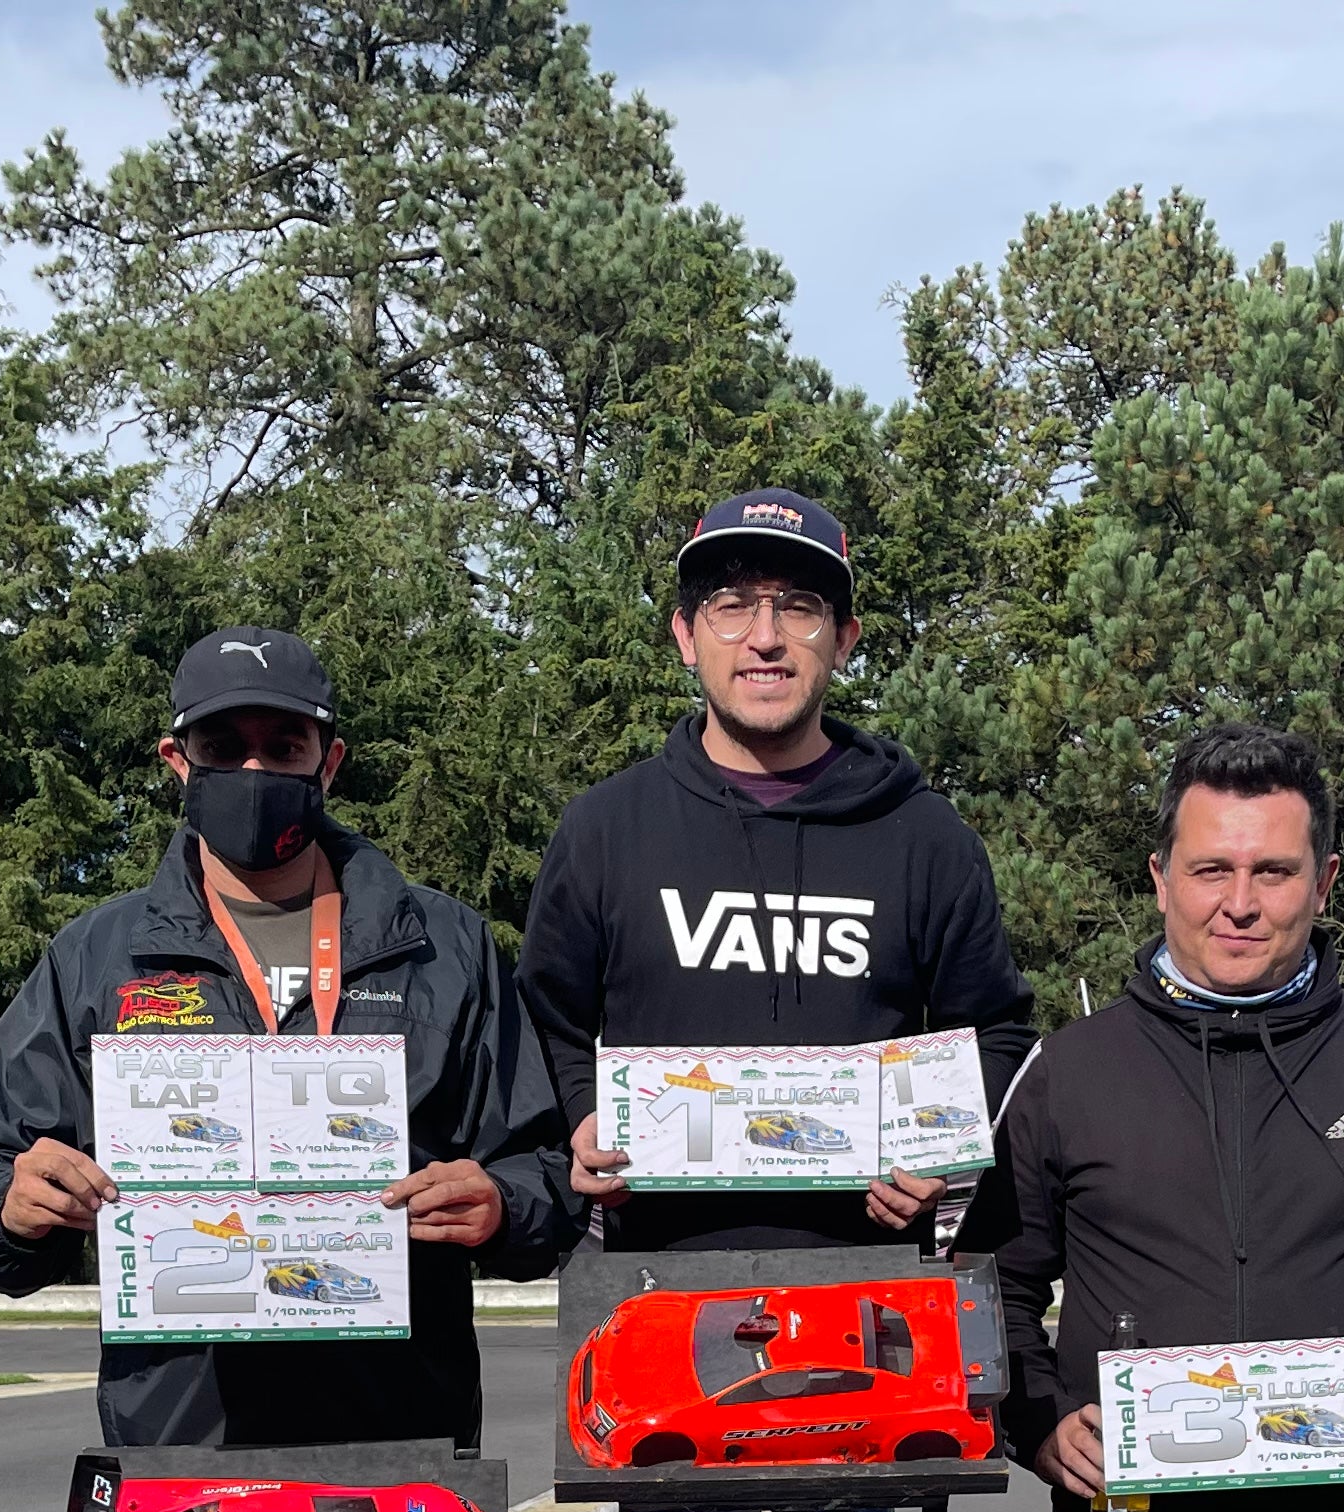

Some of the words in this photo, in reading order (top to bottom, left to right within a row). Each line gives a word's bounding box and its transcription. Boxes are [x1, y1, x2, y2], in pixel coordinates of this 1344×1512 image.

[660, 888, 875, 978] VANS
[348, 988, 403, 1003] Columbia
[137, 1014, 179, 1026] CONTROL
[115, 1053, 231, 1079] FAST
[271, 1060, 389, 1106] TQ
[611, 1064, 631, 1090] A
[130, 1083, 219, 1109] LAP
[714, 1087, 753, 1105] ER
[758, 1087, 859, 1106] LUGAR
[137, 1145, 164, 1154] 1/10
[166, 1144, 193, 1153] Nitro
[194, 1145, 213, 1153] Pro
[296, 1144, 322, 1154] 1/10
[323, 1144, 350, 1153] Nitro
[352, 1144, 371, 1152] Pro
[888, 1138, 913, 1149] 1/10
[913, 1134, 938, 1145] Nitro
[939, 1132, 956, 1142] Pro
[745, 1157, 773, 1167] 1/10
[776, 1157, 805, 1166] Nitro
[808, 1157, 829, 1166] Pro
[114, 1210, 135, 1236] A
[282, 1232, 393, 1252] LUGAR
[118, 1243, 138, 1318] Final
[264, 1307, 296, 1317] 1/10
[299, 1307, 331, 1316] Nitro
[334, 1307, 356, 1315] Pro
[1115, 1366, 1135, 1392] A
[1222, 1384, 1263, 1403] ER
[721, 1420, 870, 1441] SERPENT
[1115, 1399, 1138, 1470] Final
[1257, 1452, 1288, 1463] 1/10
[1291, 1451, 1321, 1461] Nitro
